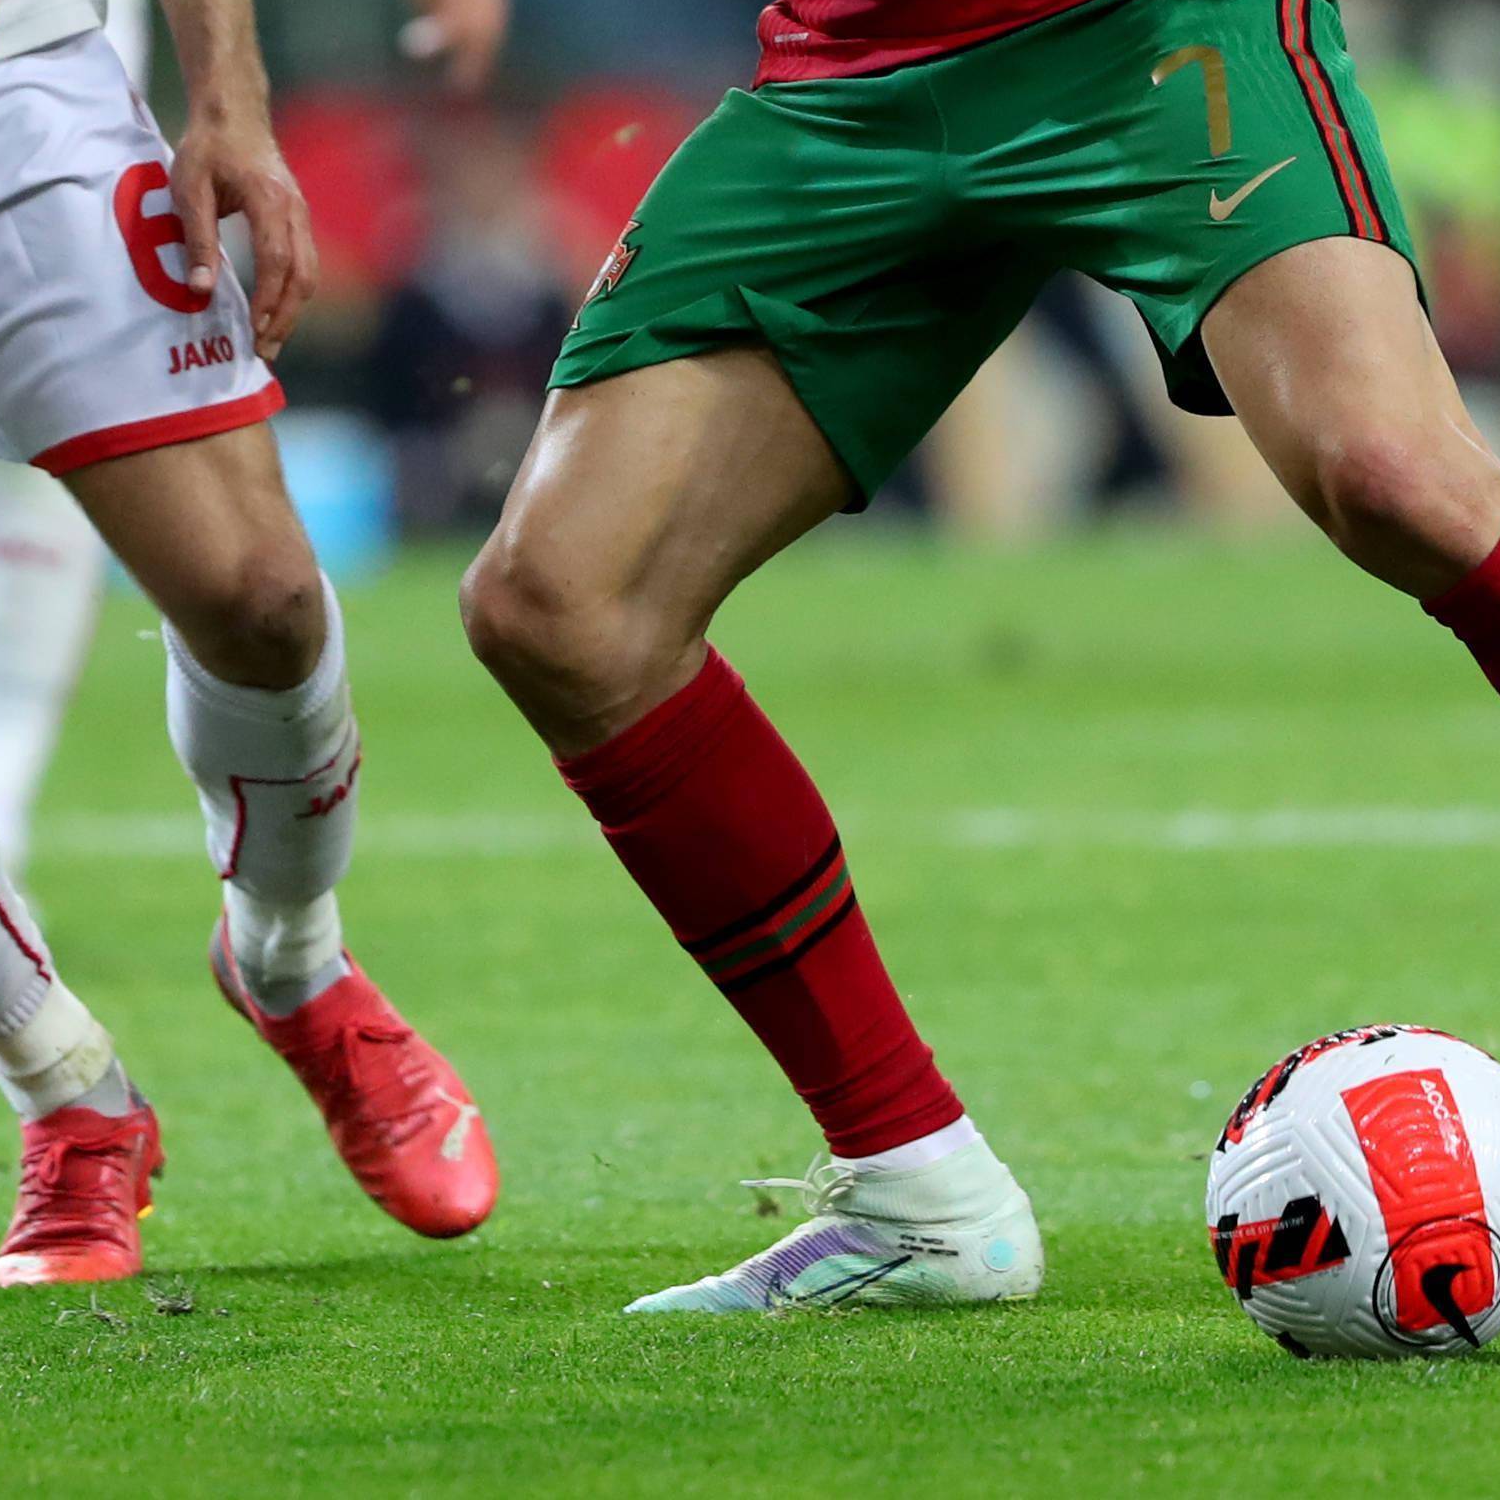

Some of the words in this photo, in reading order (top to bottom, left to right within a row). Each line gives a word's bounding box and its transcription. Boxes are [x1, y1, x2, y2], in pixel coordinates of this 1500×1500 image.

[1150, 44, 1232, 159] 7
[113, 160, 213, 314] 6
[167, 335, 236, 375] JAKO
